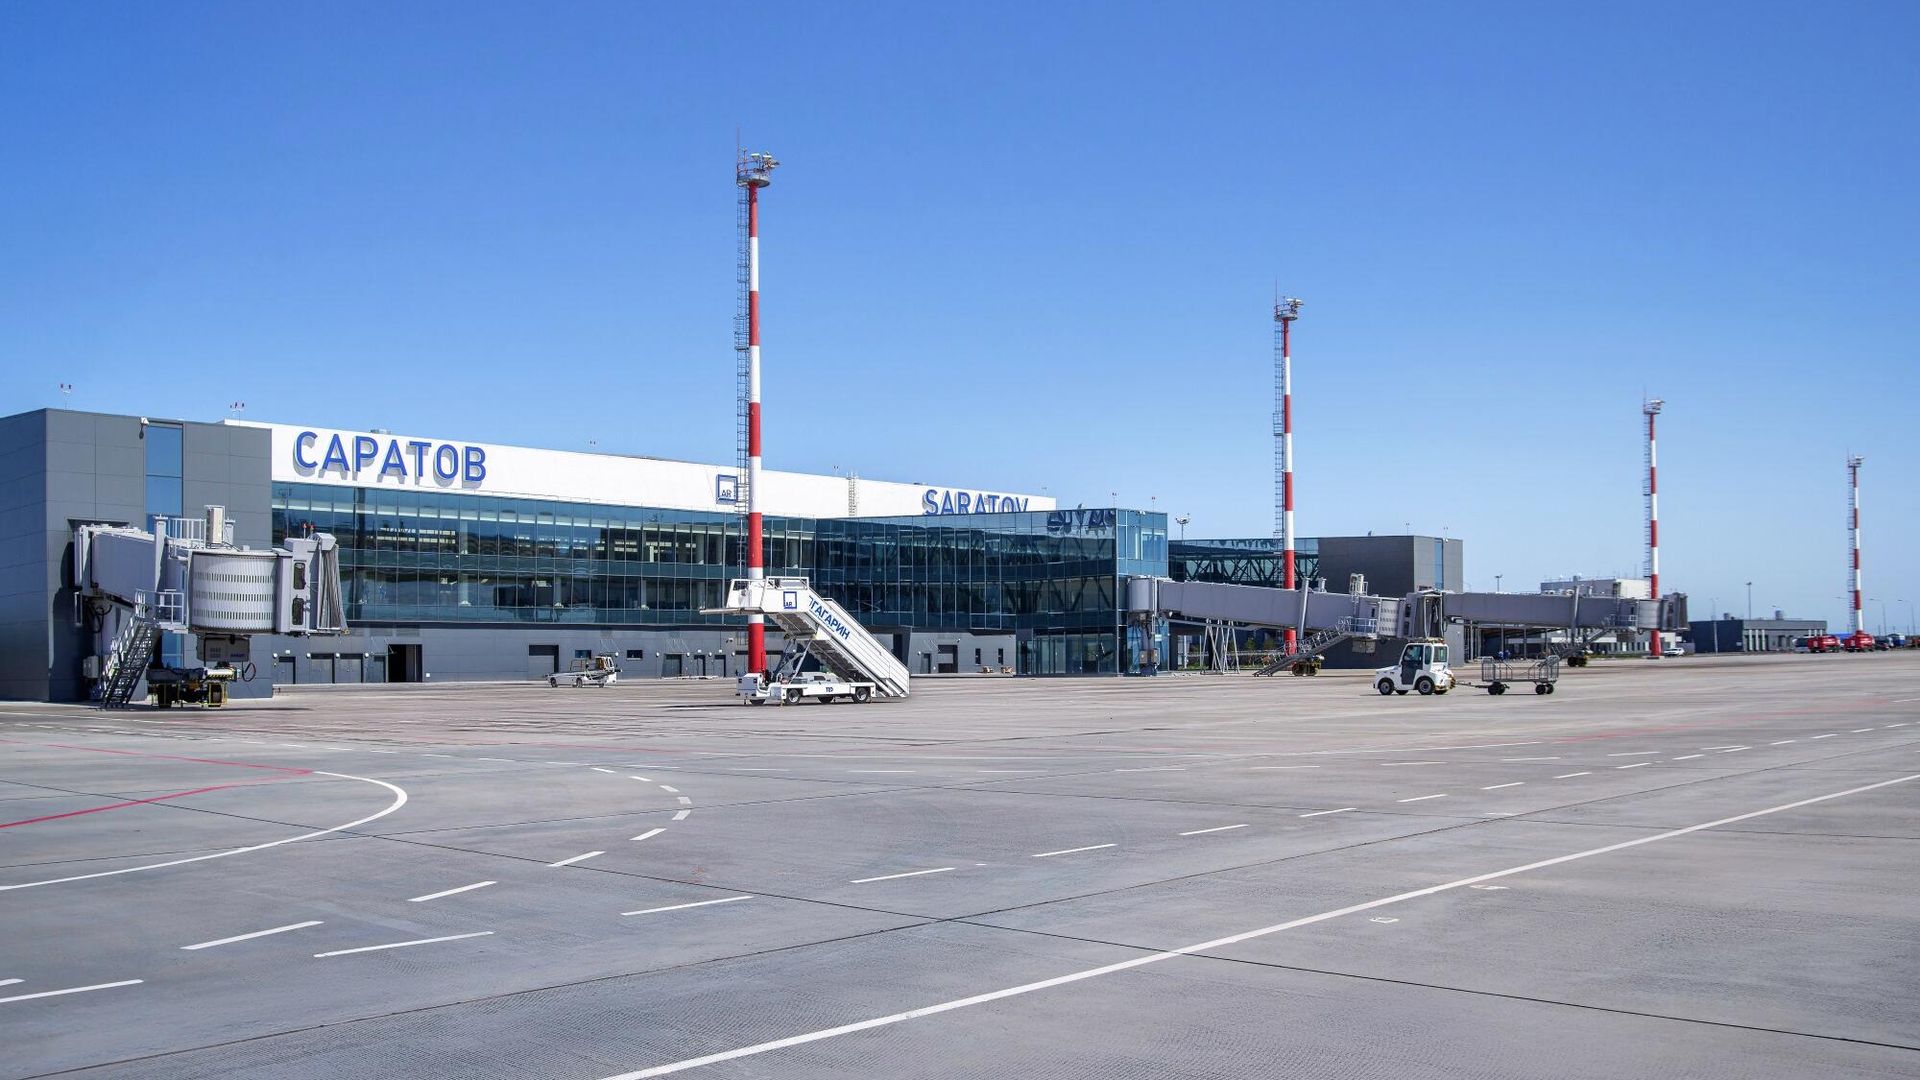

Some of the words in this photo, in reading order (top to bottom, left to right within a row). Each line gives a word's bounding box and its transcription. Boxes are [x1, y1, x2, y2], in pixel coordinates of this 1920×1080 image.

[295, 431, 487, 482] САРАТОВ
[925, 489, 1029, 515] SARATOV
[810, 600, 851, 640] ГАГАРИН
